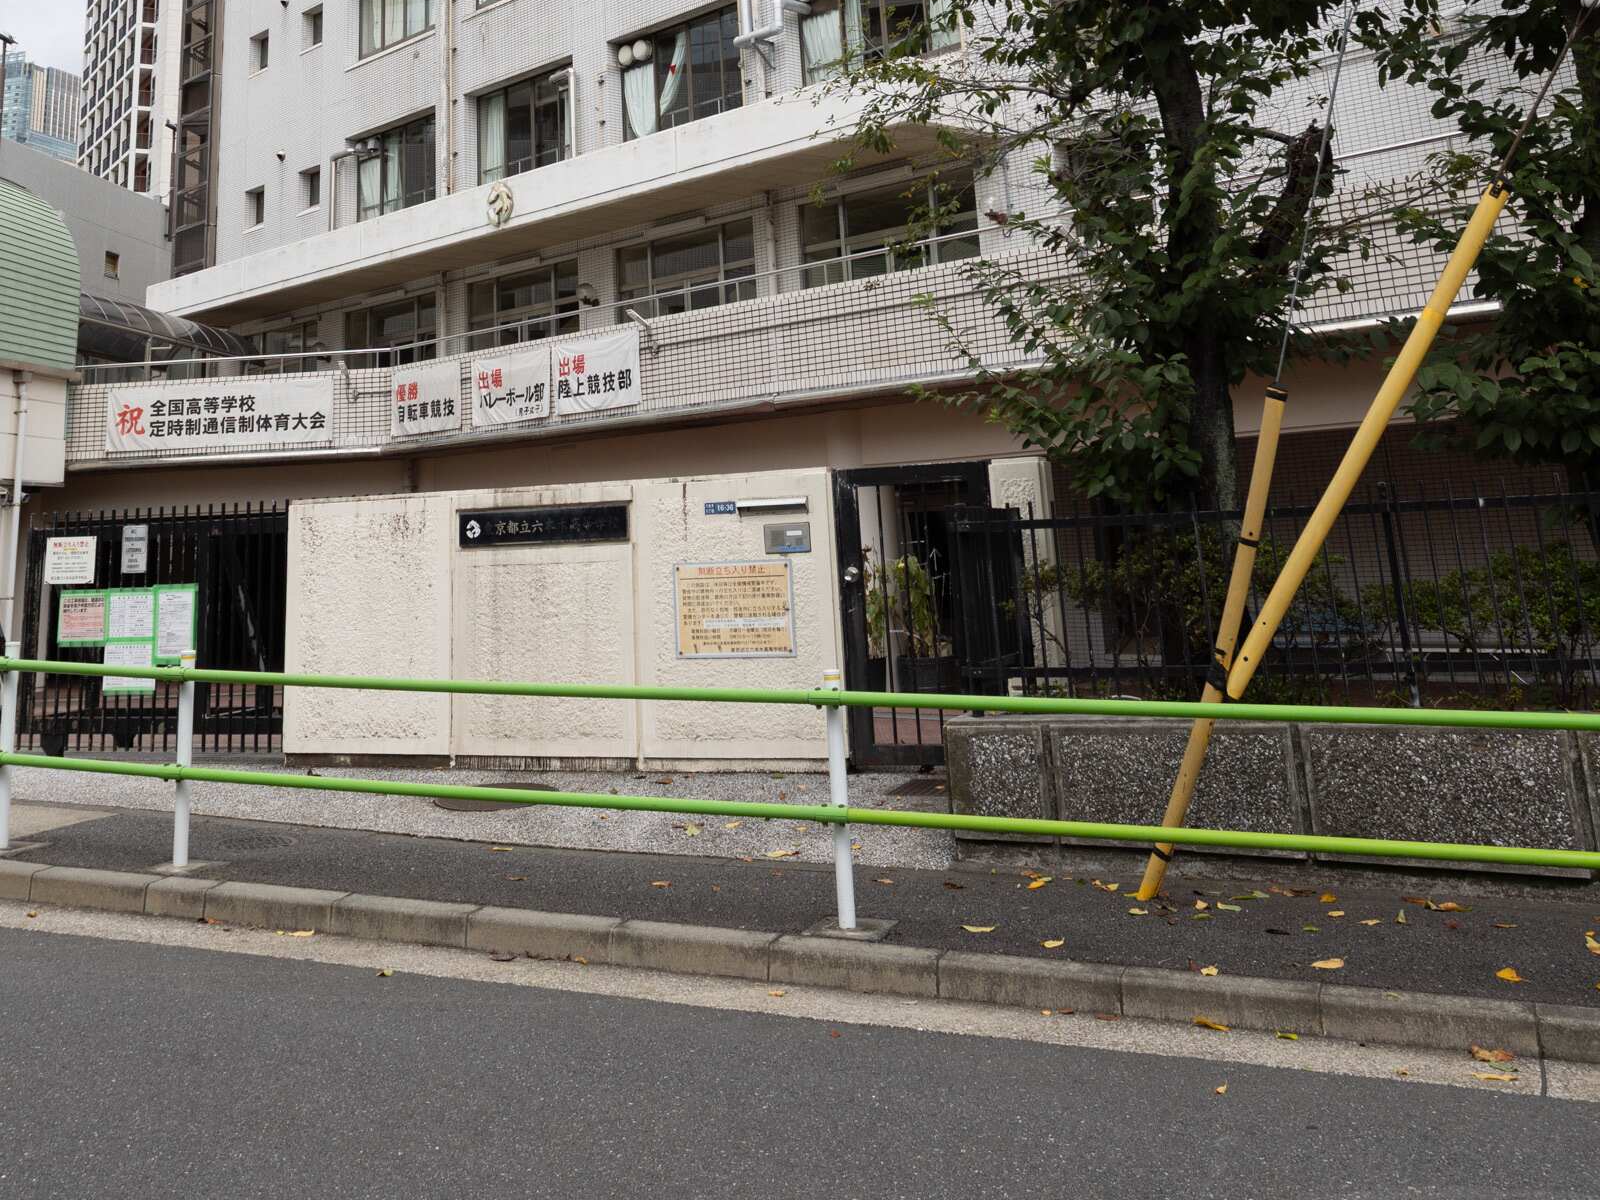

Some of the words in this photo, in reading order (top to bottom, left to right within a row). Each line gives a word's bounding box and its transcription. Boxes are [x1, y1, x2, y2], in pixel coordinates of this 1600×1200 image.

[559, 353, 585, 377] 出場
[478, 368, 503, 390] 出場
[558, 368, 632, 400] 陸上競技部
[396, 381, 418, 402] 優勝
[150, 395, 256, 417] 全国高等学校
[398, 398, 455, 423] 自転車競技
[115, 404, 145, 436] 祝
[149, 411, 326, 438] 定時制通信制体育大会
